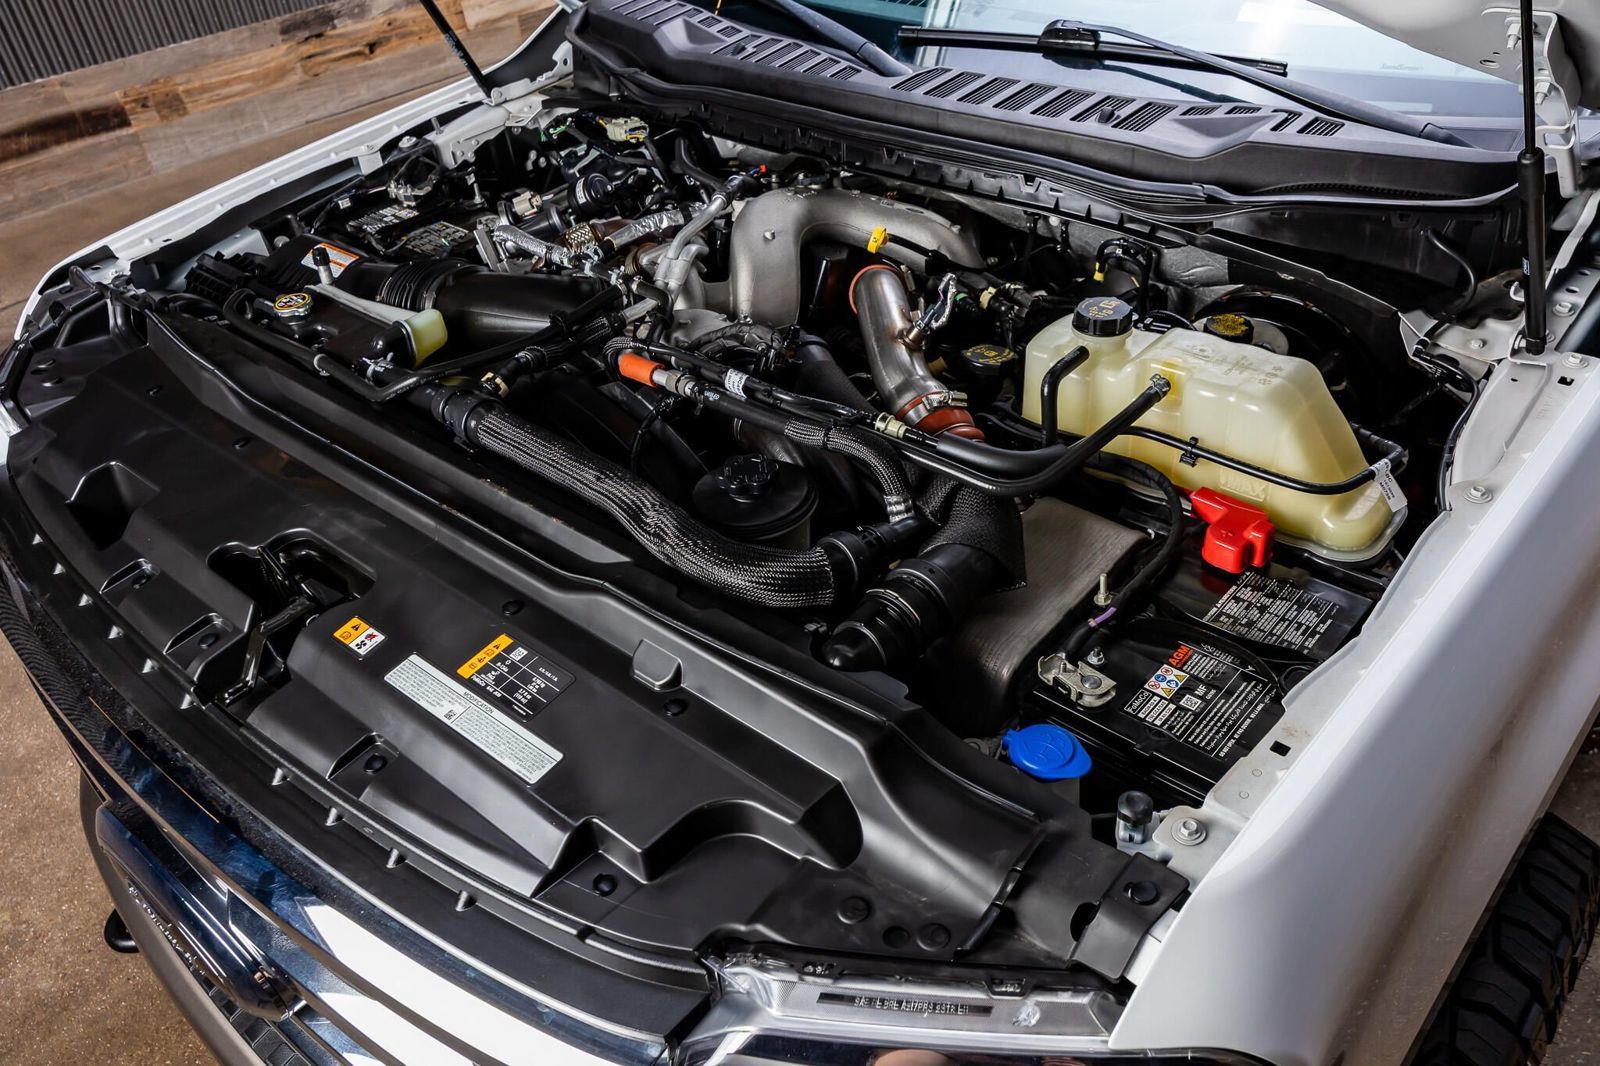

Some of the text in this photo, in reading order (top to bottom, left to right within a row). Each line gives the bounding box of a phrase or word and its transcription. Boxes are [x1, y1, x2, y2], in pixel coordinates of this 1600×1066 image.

[1167, 645, 1189, 665] AGM
[1194, 683, 1207, 695] MF
[463, 691, 494, 713] MODIFICATION
[1127, 691, 1148, 712] FoMoCo
